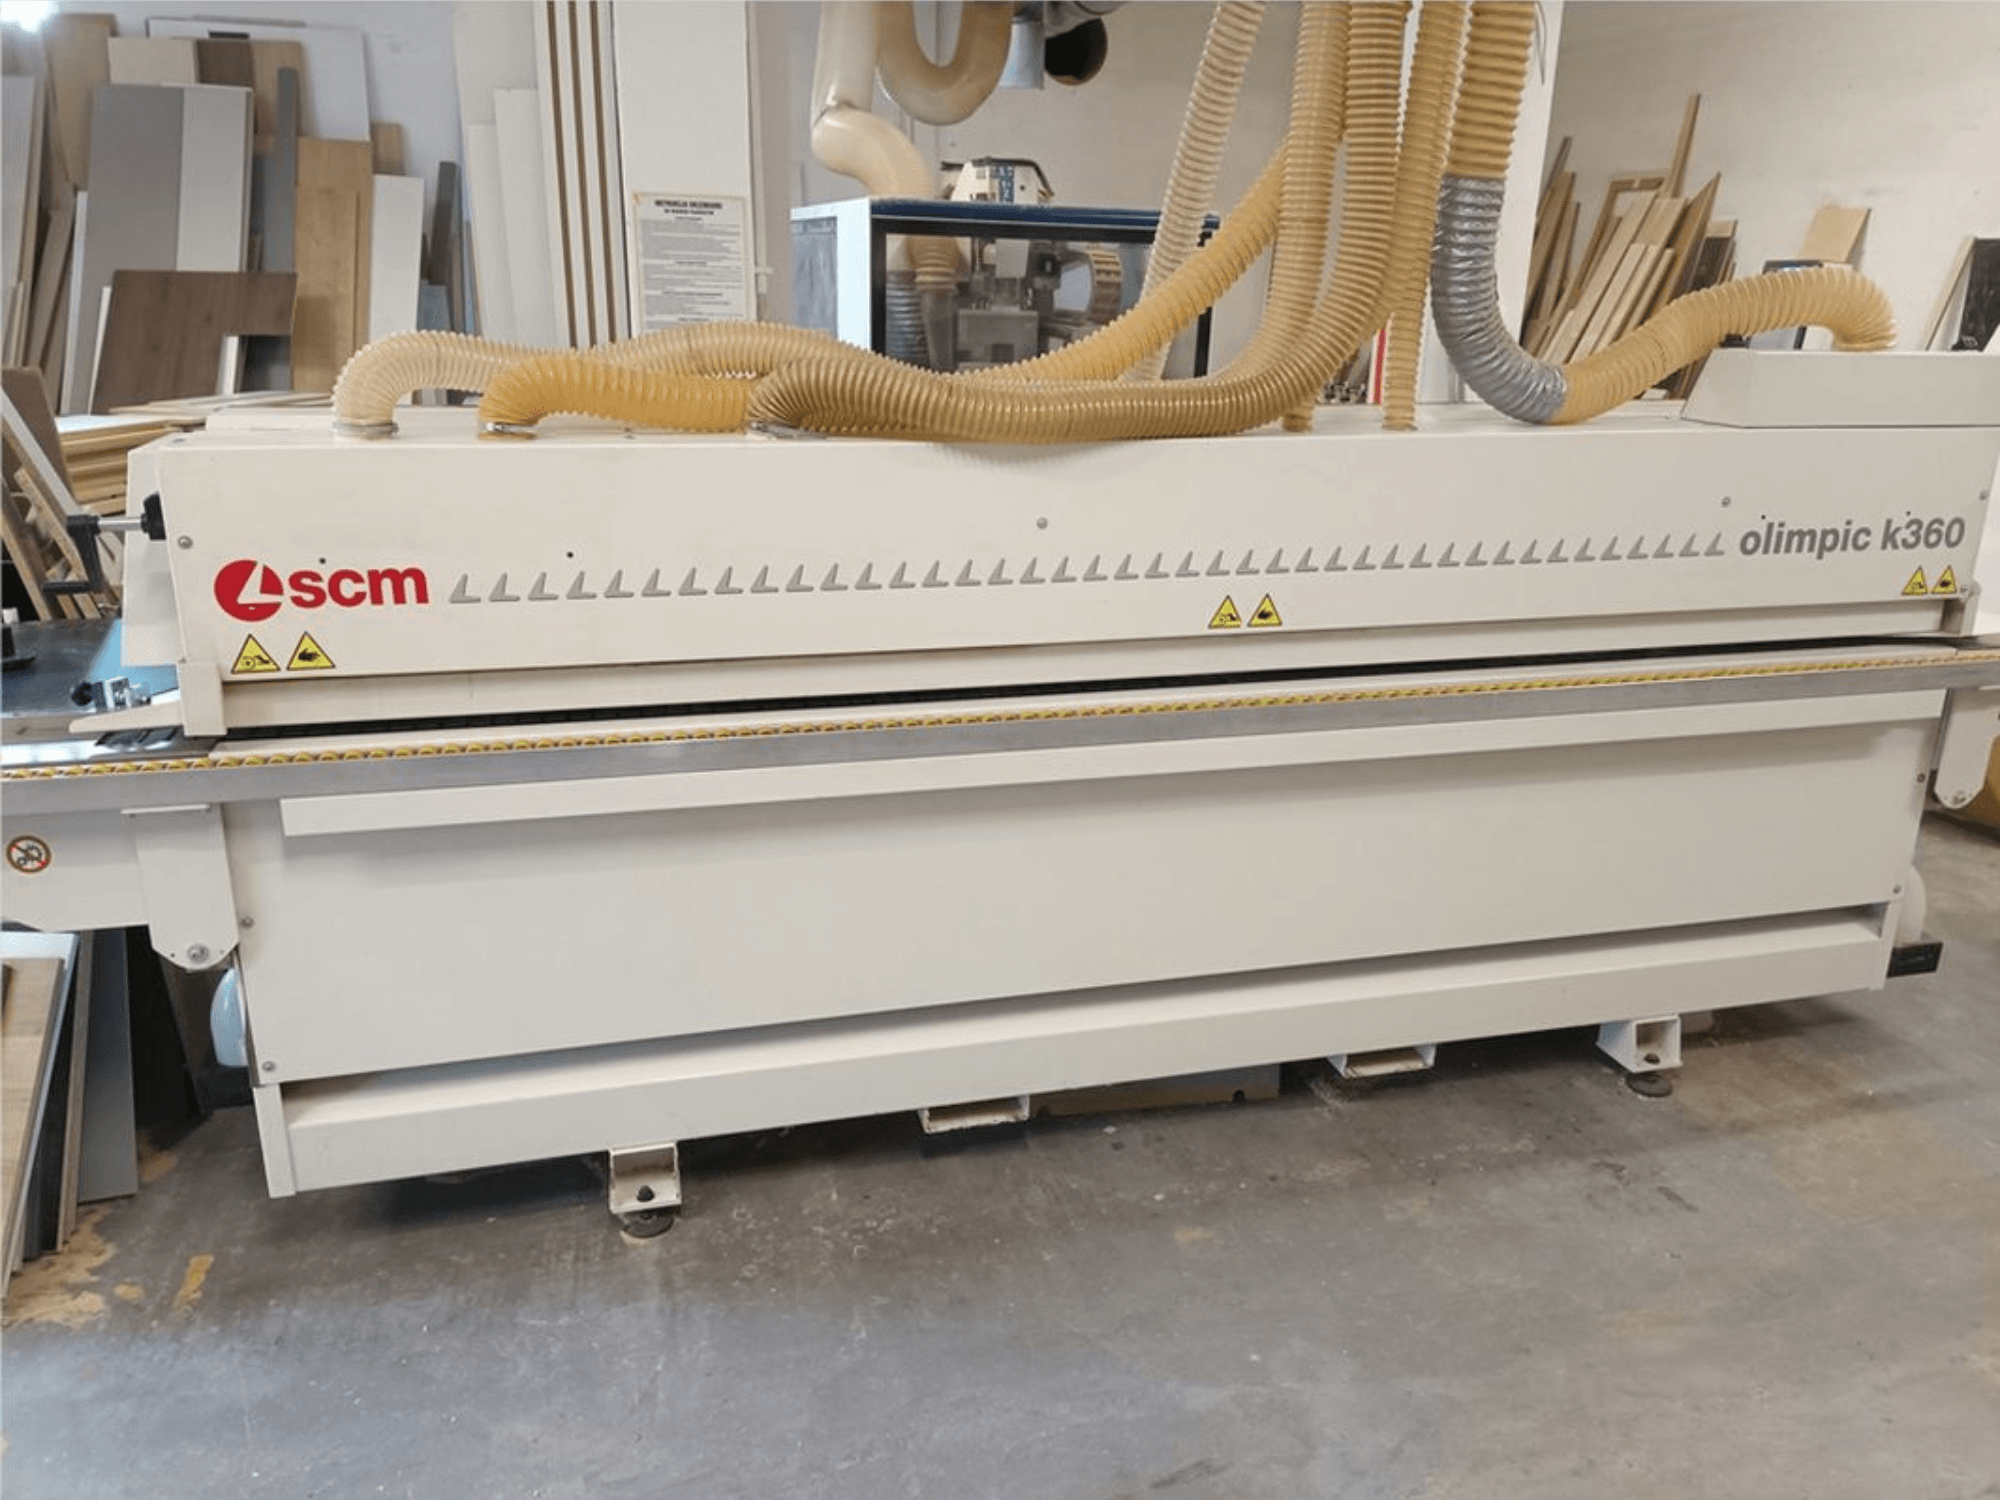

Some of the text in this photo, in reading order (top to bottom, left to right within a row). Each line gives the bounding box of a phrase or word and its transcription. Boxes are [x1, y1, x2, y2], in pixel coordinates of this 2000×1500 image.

[1740, 517, 1965, 560] olimpic k360
[288, 567, 429, 609] scm
